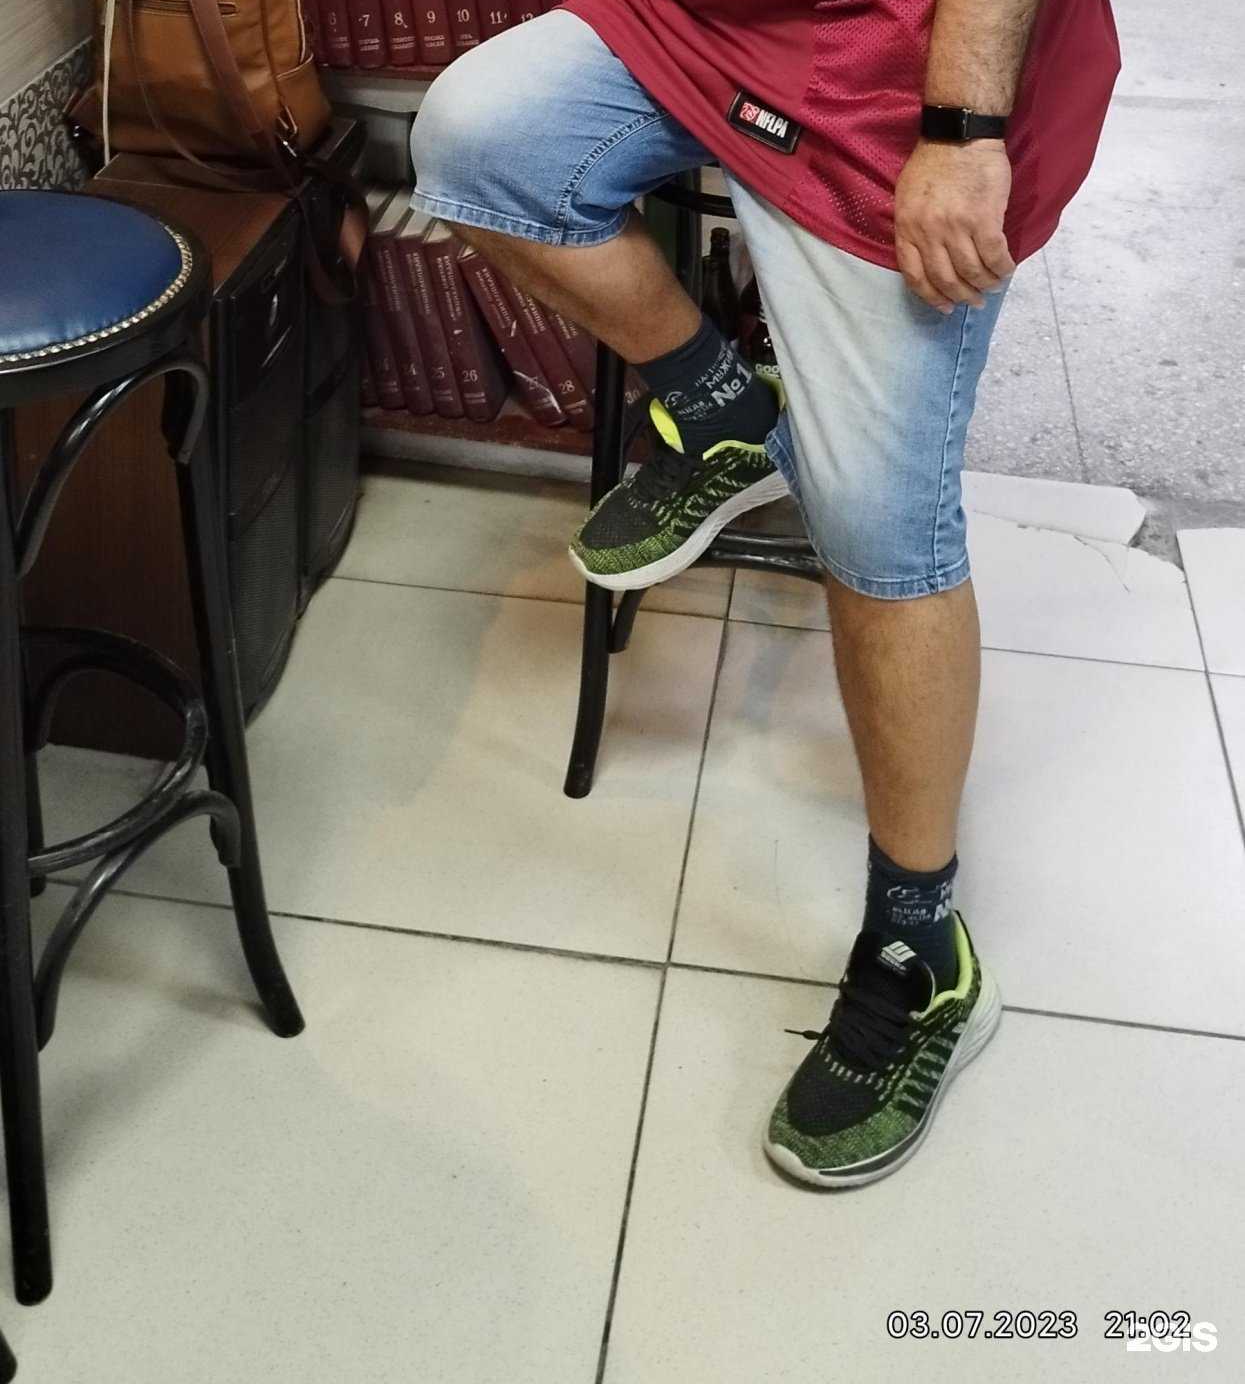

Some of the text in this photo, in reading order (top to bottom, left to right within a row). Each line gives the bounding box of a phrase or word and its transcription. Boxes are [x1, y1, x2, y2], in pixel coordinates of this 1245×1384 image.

[394, 11, 404, 26] 8
[426, 10, 436, 24] 9
[456, 8, 470, 23] 10
[756, 109, 789, 139] NFLPA
[462, 369, 479, 383] 26
